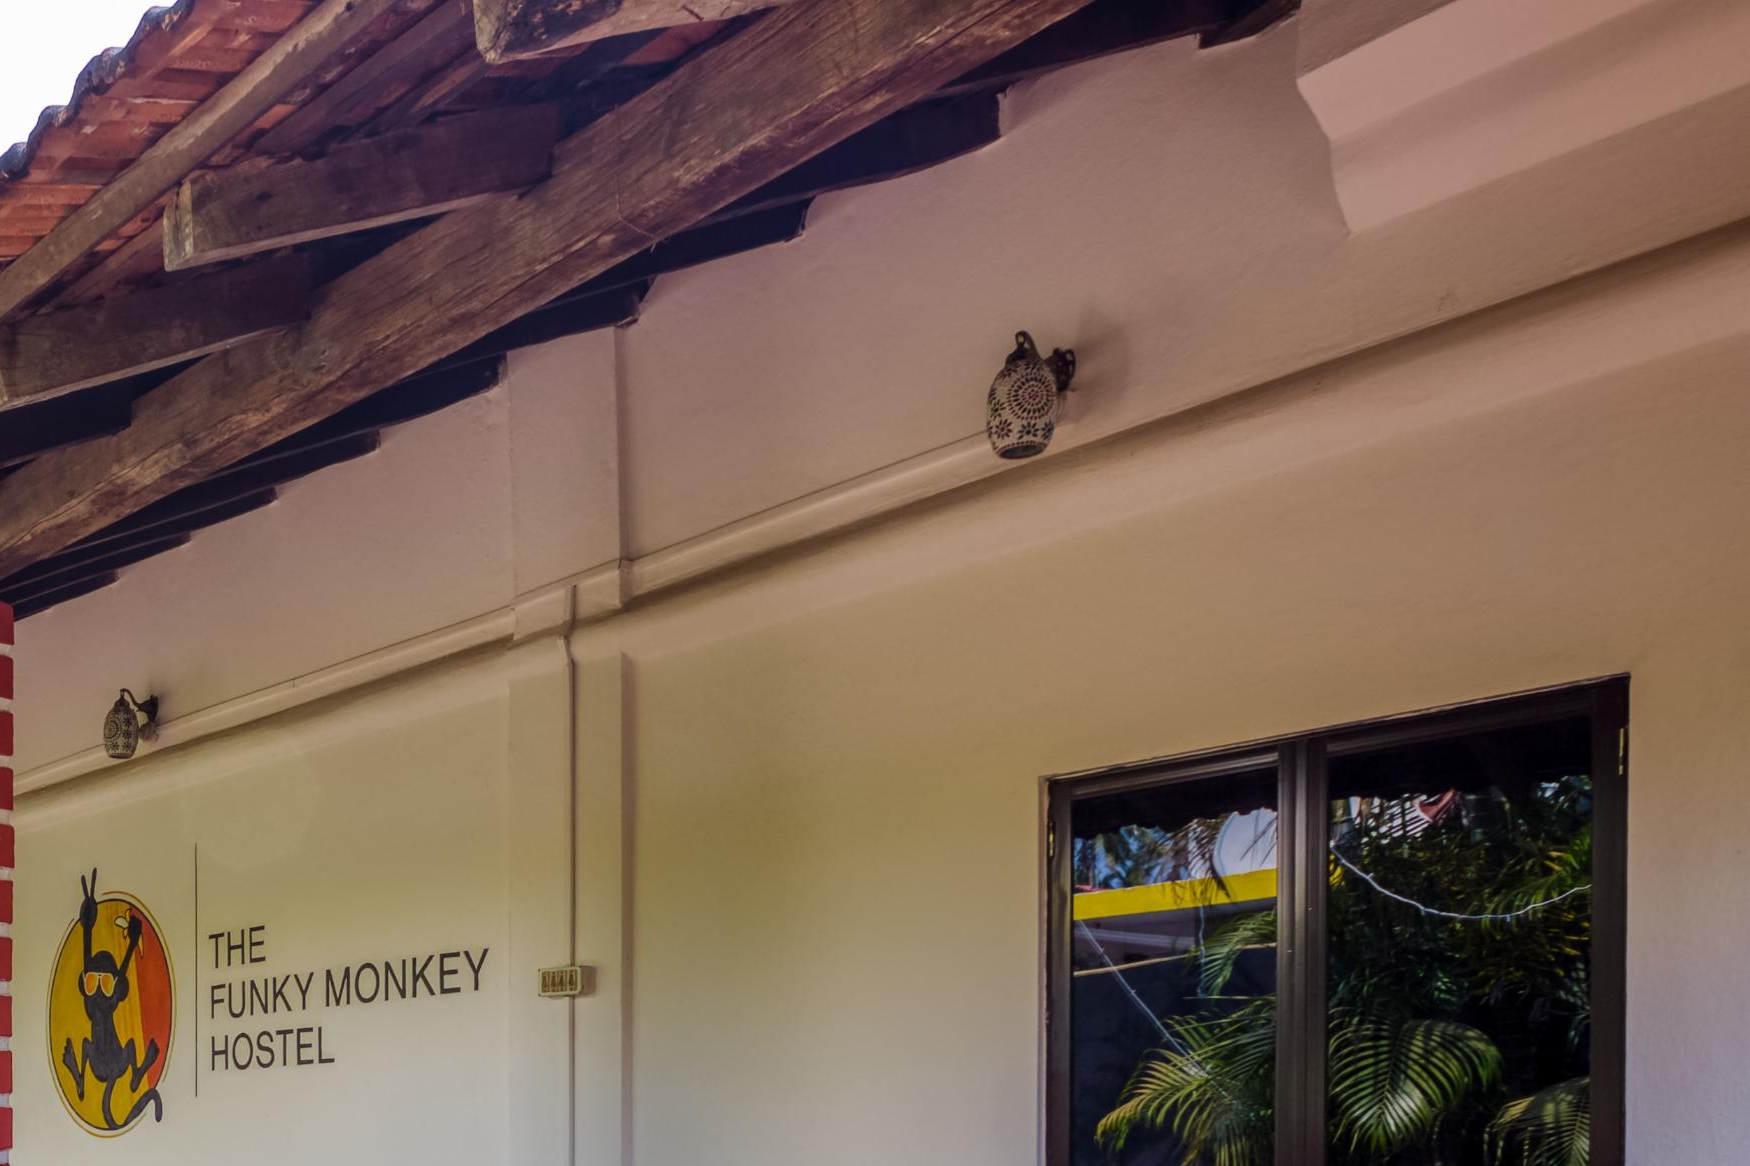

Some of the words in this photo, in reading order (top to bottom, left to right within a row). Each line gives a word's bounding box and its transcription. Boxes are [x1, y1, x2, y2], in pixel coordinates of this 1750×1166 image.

[208, 925, 266, 969] THE
[210, 972, 314, 1019] FUNKY
[325, 948, 489, 1007] MONKEY
[211, 1026, 335, 1071] HOSTEL
